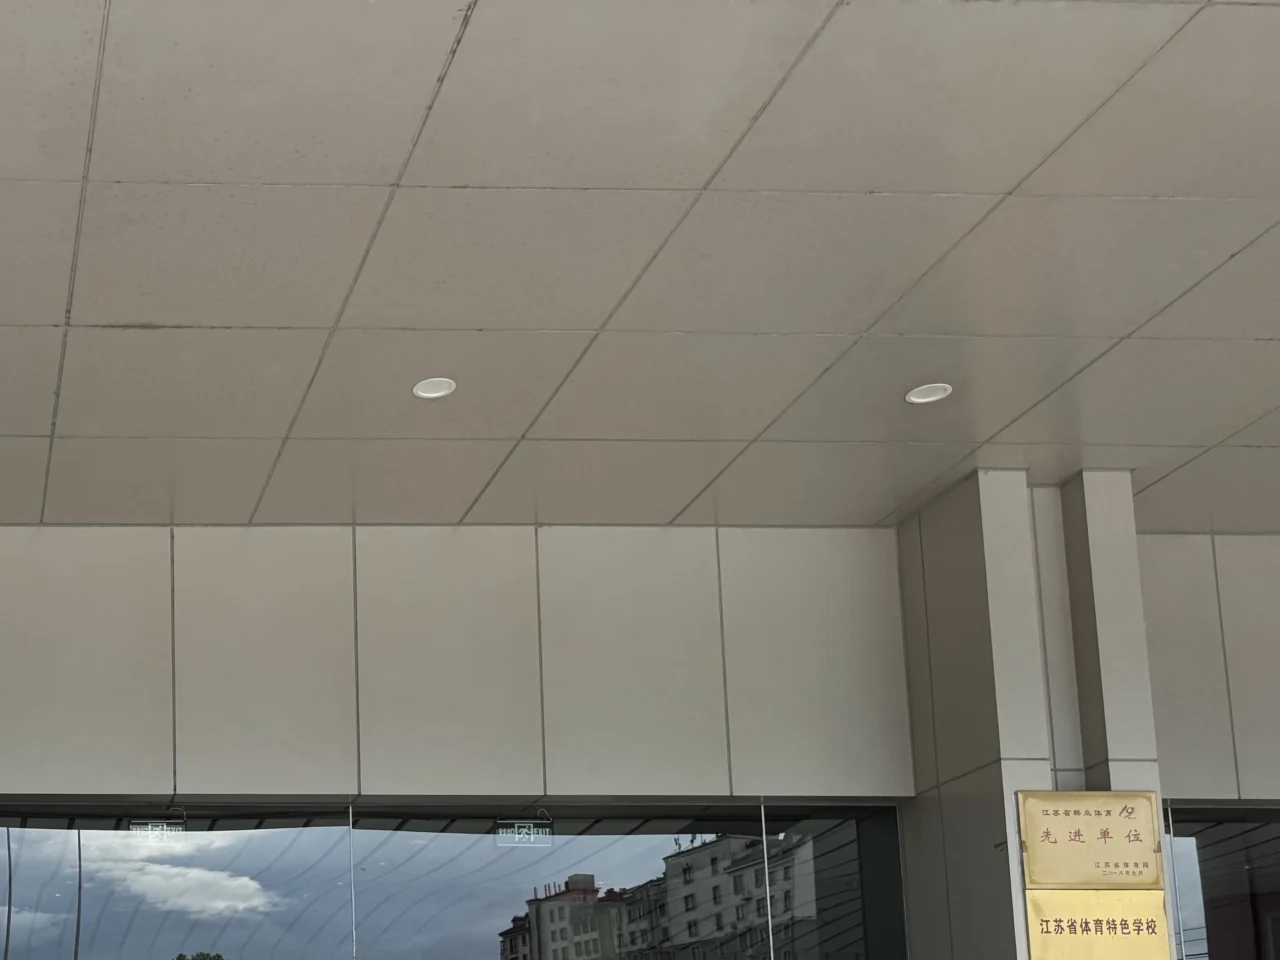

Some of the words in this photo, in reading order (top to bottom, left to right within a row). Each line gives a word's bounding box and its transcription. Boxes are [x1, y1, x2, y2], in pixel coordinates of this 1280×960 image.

[534, 828, 550, 836] EXIT
[1040, 828, 1143, 844] 先进单位
[1040, 918, 1157, 935] 江苏省体育特色学校
